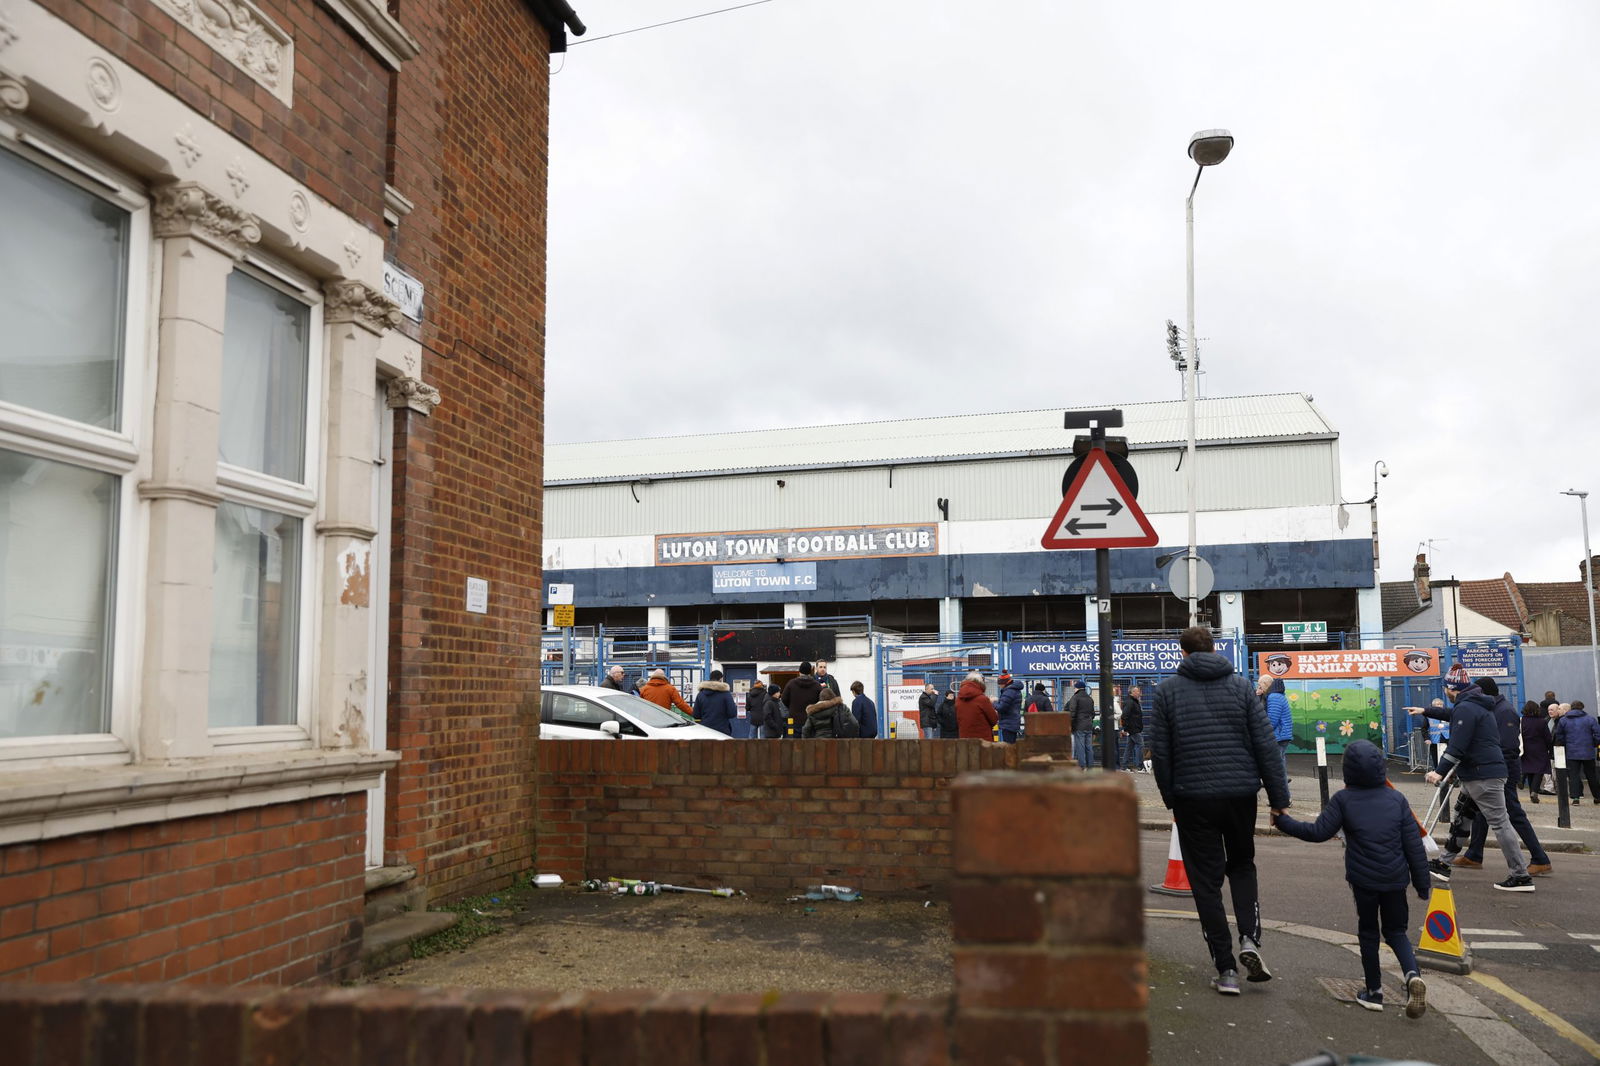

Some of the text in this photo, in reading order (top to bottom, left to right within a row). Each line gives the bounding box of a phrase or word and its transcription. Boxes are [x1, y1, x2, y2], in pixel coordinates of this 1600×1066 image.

[662, 531, 930, 558] LUTON TOWN FOOTBALL CLUB
[714, 568, 767, 578] WELCOME TO
[714, 575, 816, 588] LUTON TOWN F.C.
[1101, 601, 1109, 611] 7
[1021, 644, 1056, 653] MATCH
[1059, 644, 1067, 653] &
[1069, 643, 1100, 653] SEASO
[1114, 642, 1148, 652] TICKET
[1150, 642, 1182, 651] HOLD
[1059, 651, 1184, 662] HOME SPORTERS ONLY
[1298, 653, 1397, 663] HAPPY HARRY'S
[1029, 662, 1092, 671] KENILWORTH
[1112, 660, 1158, 671] SEATING,
[1298, 662, 1398, 673] FAMILY ZONE
